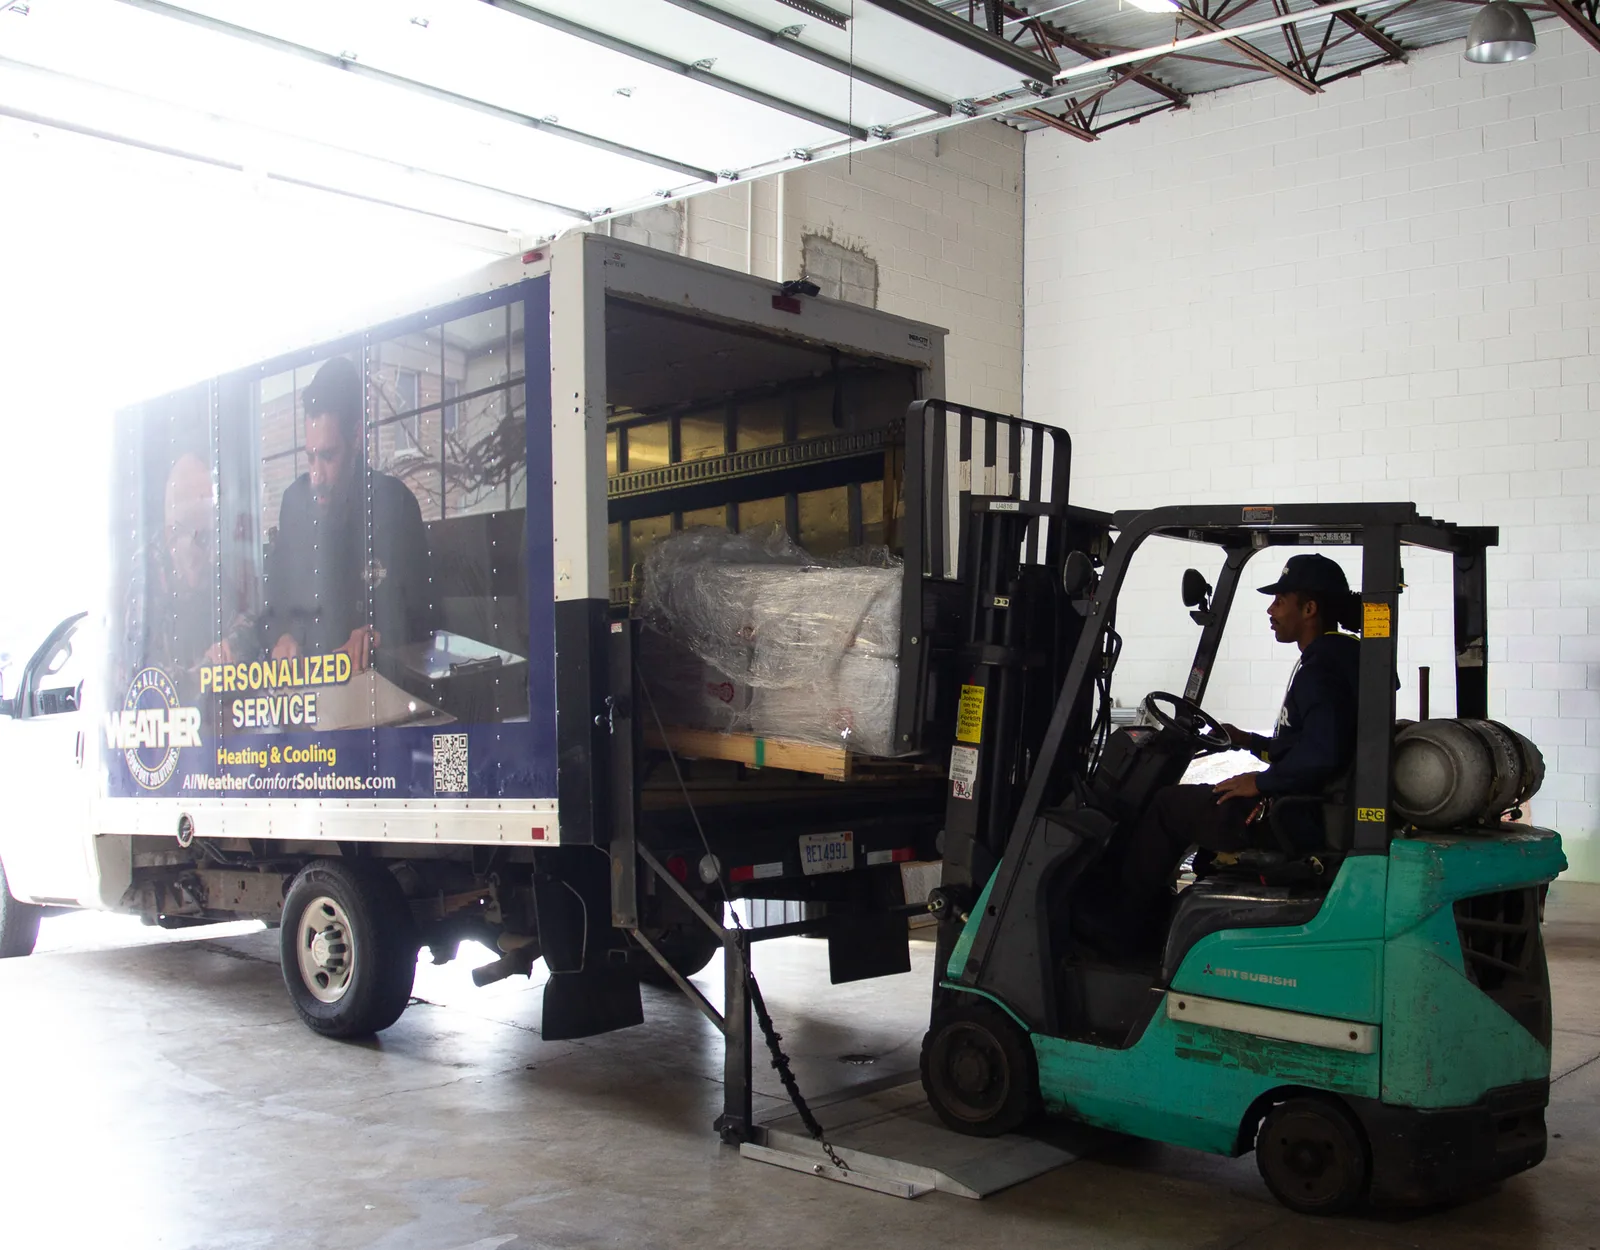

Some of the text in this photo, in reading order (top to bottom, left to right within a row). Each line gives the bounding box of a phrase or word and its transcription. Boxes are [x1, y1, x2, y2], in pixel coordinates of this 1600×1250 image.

[142, 671, 159, 687] ALL
[200, 653, 351, 693] PERSONALIZED
[232, 694, 317, 728] SERVICE
[964, 708, 978, 716] Spot
[104, 707, 202, 749] WEATHER
[217, 744, 337, 768] Heating & Cooling
[126, 748, 178, 786] COMFORT SOLUTIONS
[182, 772, 396, 790] AllWeatherComfortSolutions.com
[1359, 809, 1384, 820] LPG
[806, 842, 848, 863] BE14991
[1215, 968, 1297, 987] MITSUBISHI
